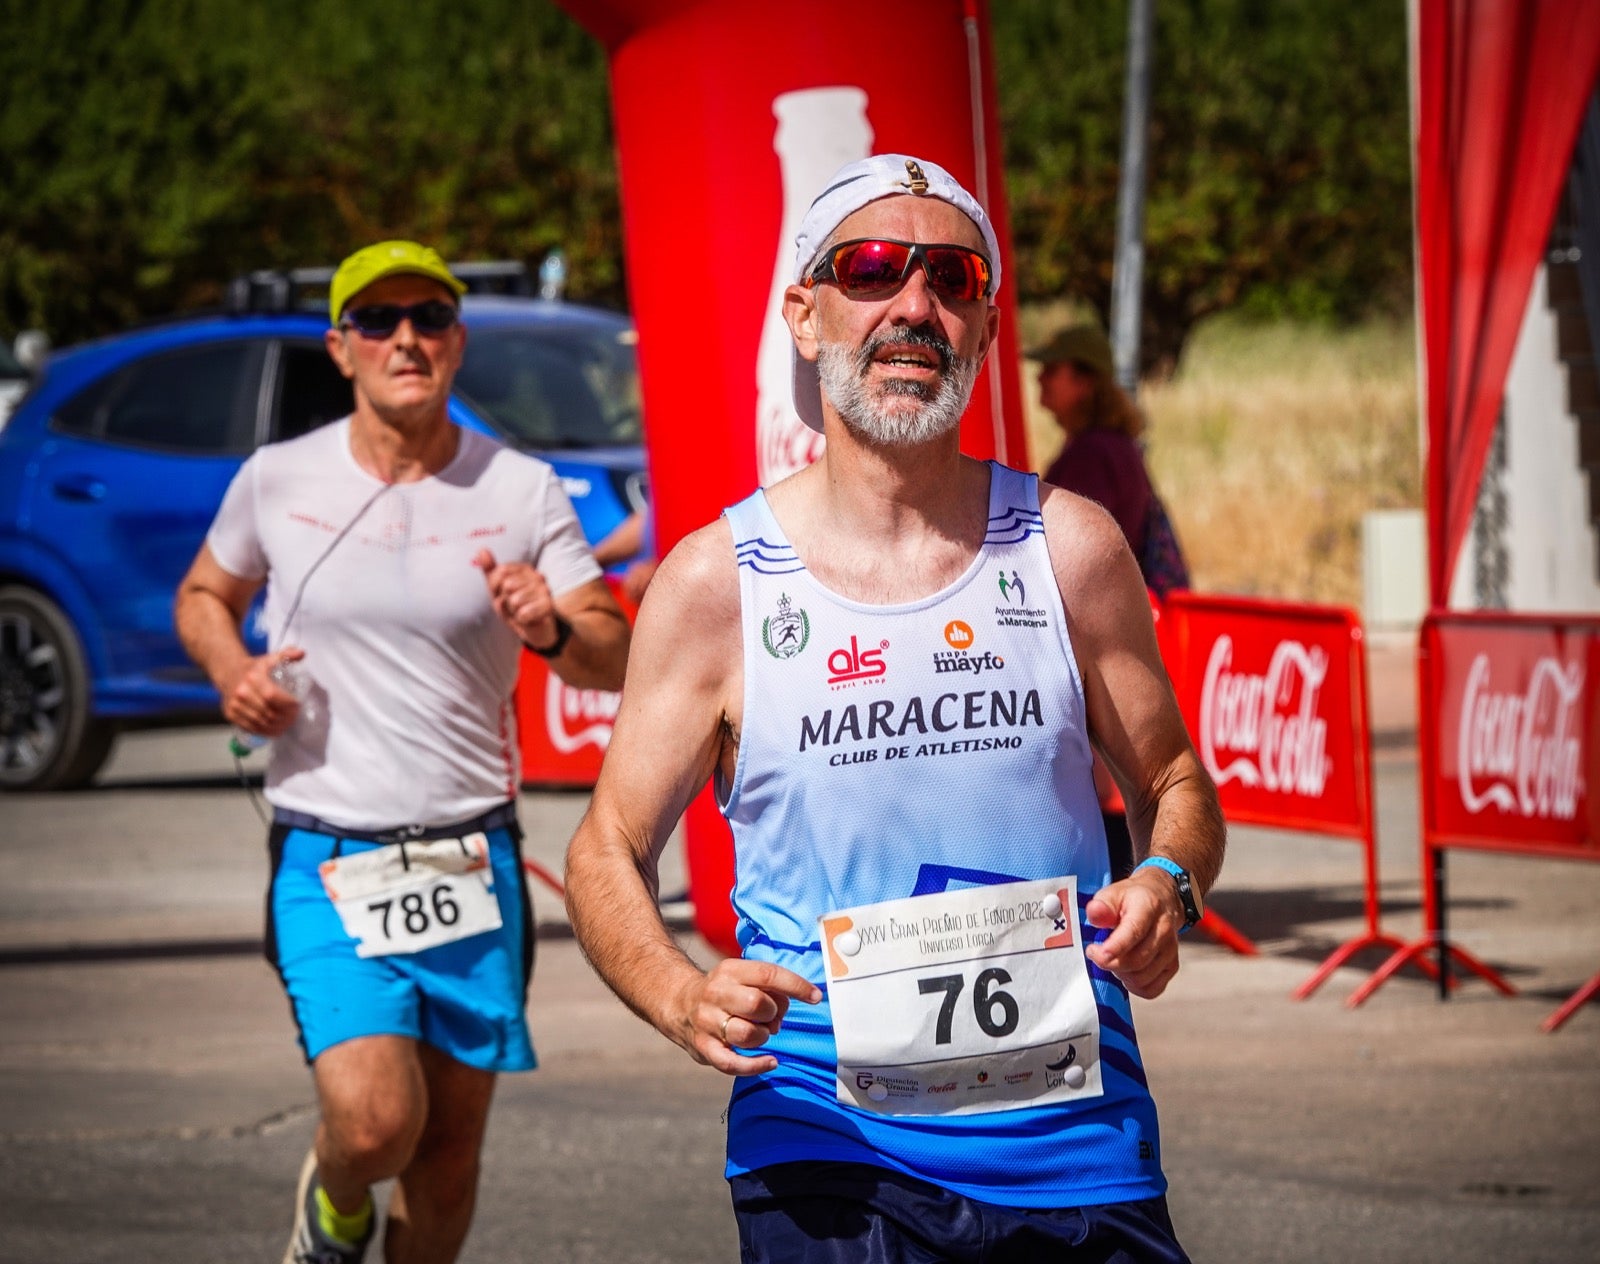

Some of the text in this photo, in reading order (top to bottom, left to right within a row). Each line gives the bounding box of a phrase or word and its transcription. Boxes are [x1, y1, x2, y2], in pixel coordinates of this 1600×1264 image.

[994, 606, 1046, 617] Ayuntamiento
[1005, 617, 1048, 628] Maracena
[933, 650, 967, 660] grupo
[934, 652, 1004, 675] mayfo
[863, 678, 886, 686] shop
[799, 689, 1044, 752] MARACENA
[829, 736, 1022, 767] CLUB DE ATLETISMO
[368, 884, 460, 940] 786
[857, 924, 886, 947] XXXV
[966, 912, 982, 930] DE
[983, 907, 1016, 927] FONDO
[1018, 900, 1046, 922] 2022
[919, 932, 996, 954] UNIVERSO LORCA
[917, 967, 1019, 1045] 76
